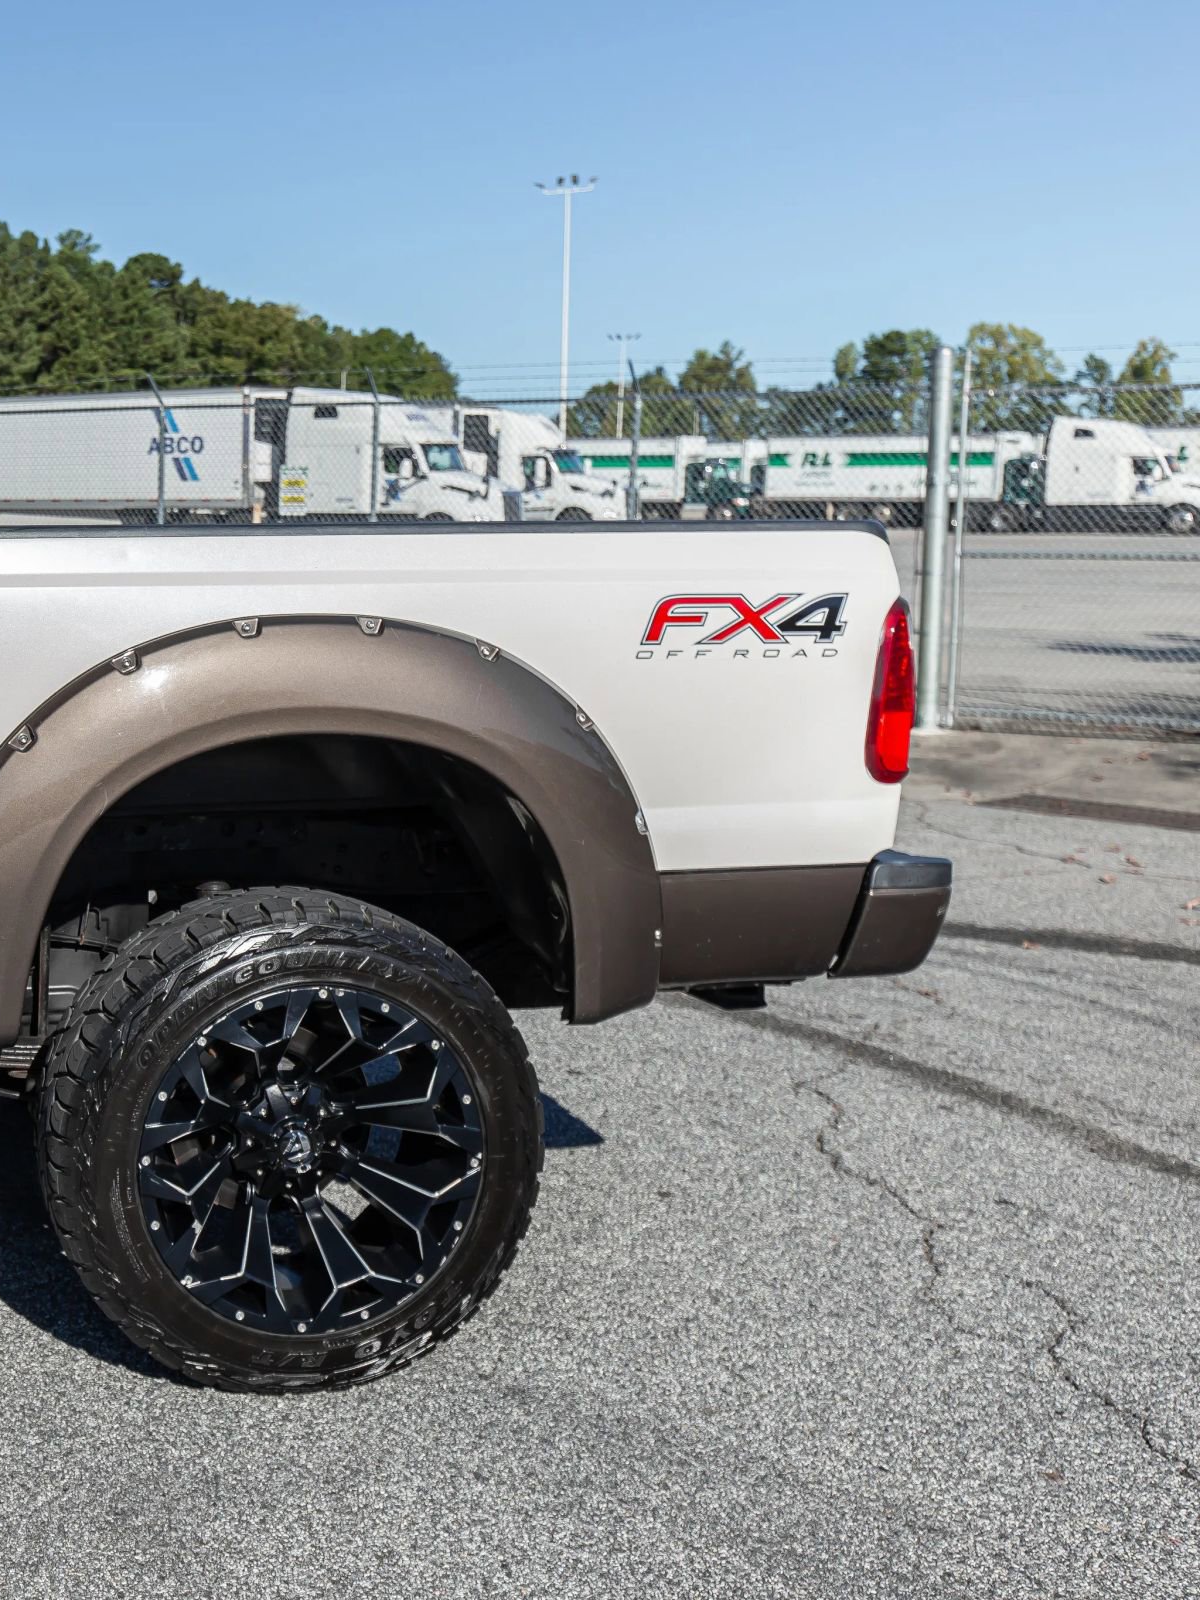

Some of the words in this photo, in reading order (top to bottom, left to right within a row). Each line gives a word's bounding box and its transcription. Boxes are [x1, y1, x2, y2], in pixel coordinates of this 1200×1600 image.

[148, 436, 204, 454] ABCO
[640, 592, 849, 646] FX4
[635, 649, 712, 661] OFF
[733, 647, 839, 660] ROAD
